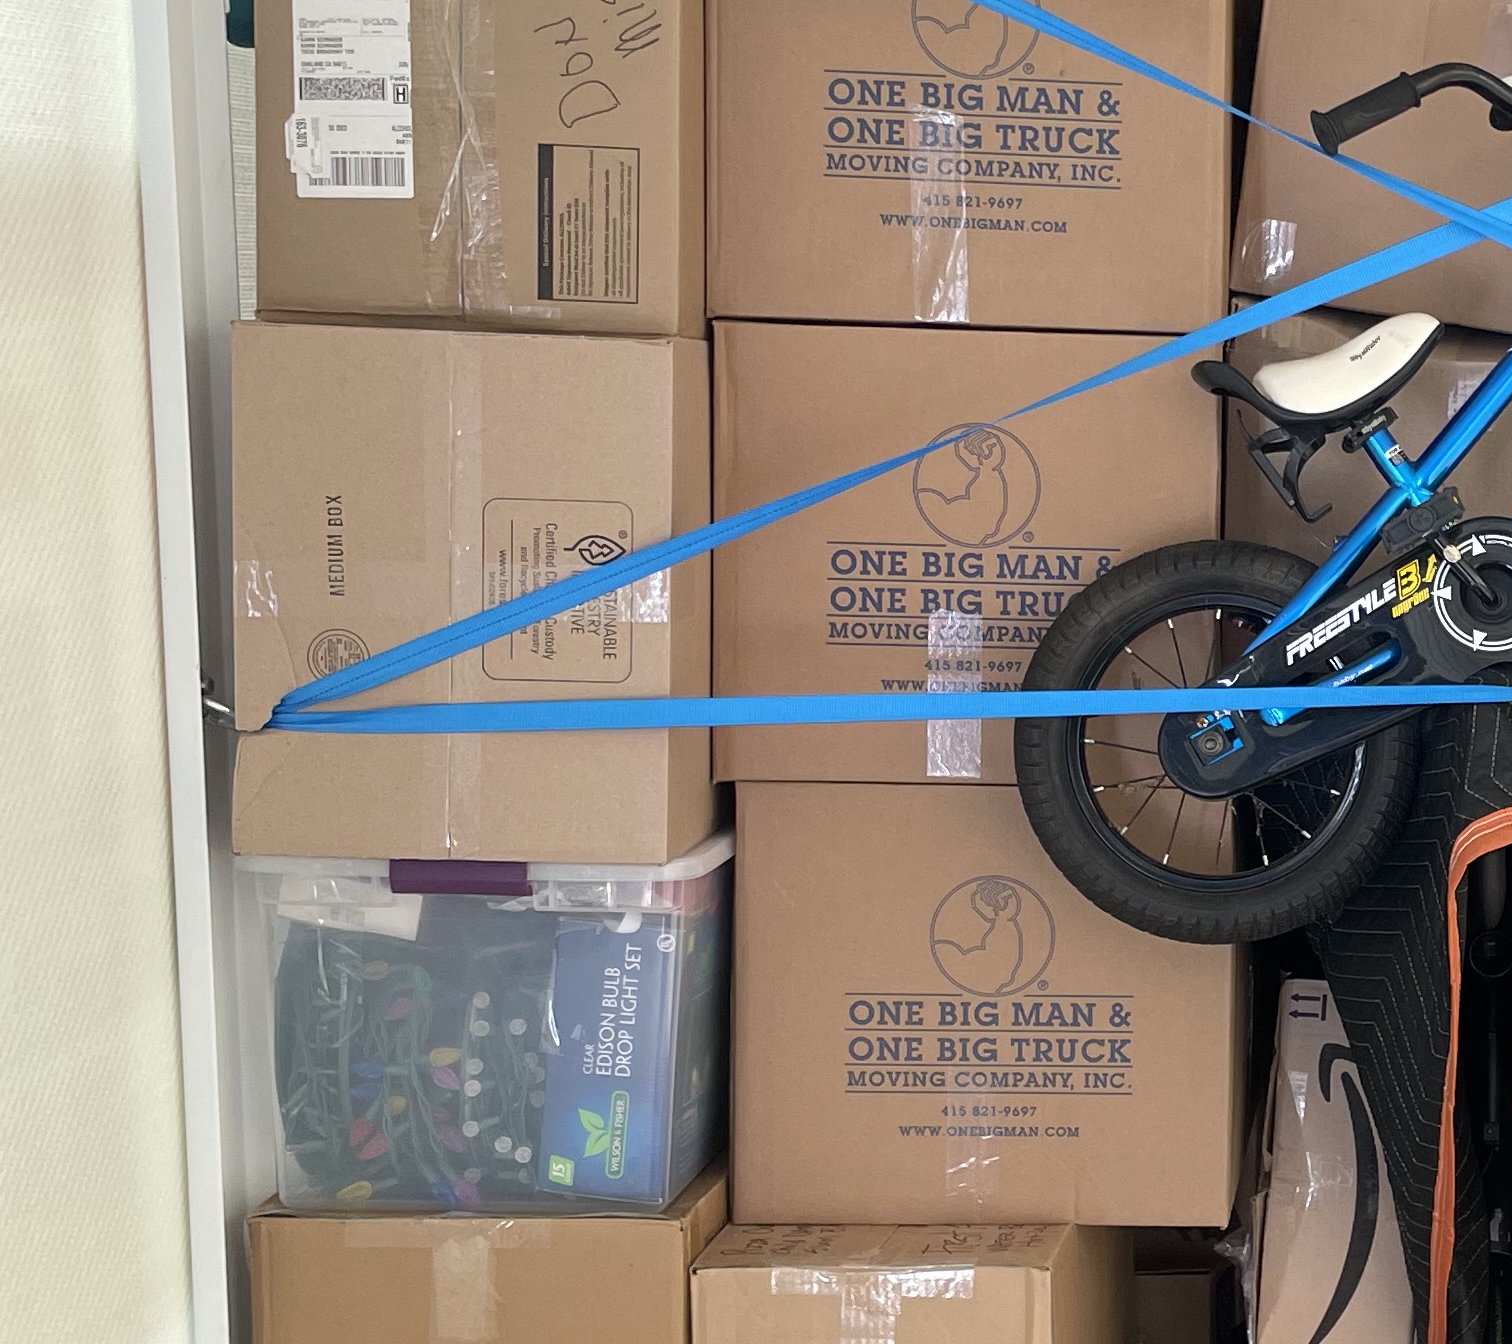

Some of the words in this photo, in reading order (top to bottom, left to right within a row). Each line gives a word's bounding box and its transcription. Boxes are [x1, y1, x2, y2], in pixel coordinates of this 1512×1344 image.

[396, 86, 406, 102] H
[828, 78, 906, 107] ONE
[920, 81, 984, 111] BIG
[996, 85, 1084, 116] MAN
[1097, 89, 1120, 117] &
[827, 116, 905, 147] ONE
[919, 119, 983, 149] BIG
[995, 124, 1120, 155] TRUCK
[826, 153, 929, 175] MOVING
[938, 157, 1062, 183] COMPANY,
[1071, 163, 1122, 183] INC.
[923, 194, 950, 207] 415
[956, 195, 1023, 210] 821-9697
[880, 213, 1068, 234] WWW.ONEBIGMAN.COM
[325, 496, 343, 527] BOX
[545, 523, 558, 569] Certified
[327, 535, 345, 597] MEDIUM
[831, 549, 907, 577] ONE
[922, 551, 984, 579] BIG
[996, 553, 1083, 581] MAN
[1096, 556, 1115, 578] &
[830, 586, 906, 614] ONE
[920, 589, 983, 616] BIG
[995, 590, 1082, 618] TRU
[828, 622, 929, 640] MOVING
[938, 623, 1050, 644] COMPAN
[1286, 577, 1396, 666] FREESTYLE
[543, 617, 558, 661] Custody
[924, 660, 950, 672] 415
[956, 660, 1022, 673] 821-9697
[625, 942, 642, 971] SET
[603, 967, 621, 1008] BULB
[620, 975, 639, 1025] LIGHT
[849, 1000, 924, 1026] ONE
[938, 1001, 999, 1027] BIG
[1011, 1002, 1096, 1027] MAN
[1108, 1002, 1131, 1027] &
[583, 1044, 595, 1075] CLEAR
[596, 1013, 616, 1076] EDISON
[615, 1030, 633, 1077] DROP
[848, 1036, 923, 1062] ONE
[937, 1037, 998, 1062] BIG
[1010, 1038, 1131, 1064] TRUCK
[846, 1071, 946, 1088] MOVING
[954, 1071, 1075, 1091] COMPANY,
[1083, 1072, 1132, 1089] INC.
[615, 1100, 626, 1128] FISHER
[940, 1106, 967, 1117] 415
[972, 1106, 1037, 1117] 821-9697
[552, 1162, 566, 1178] 15
[610, 1140, 621, 1172] WILSON
